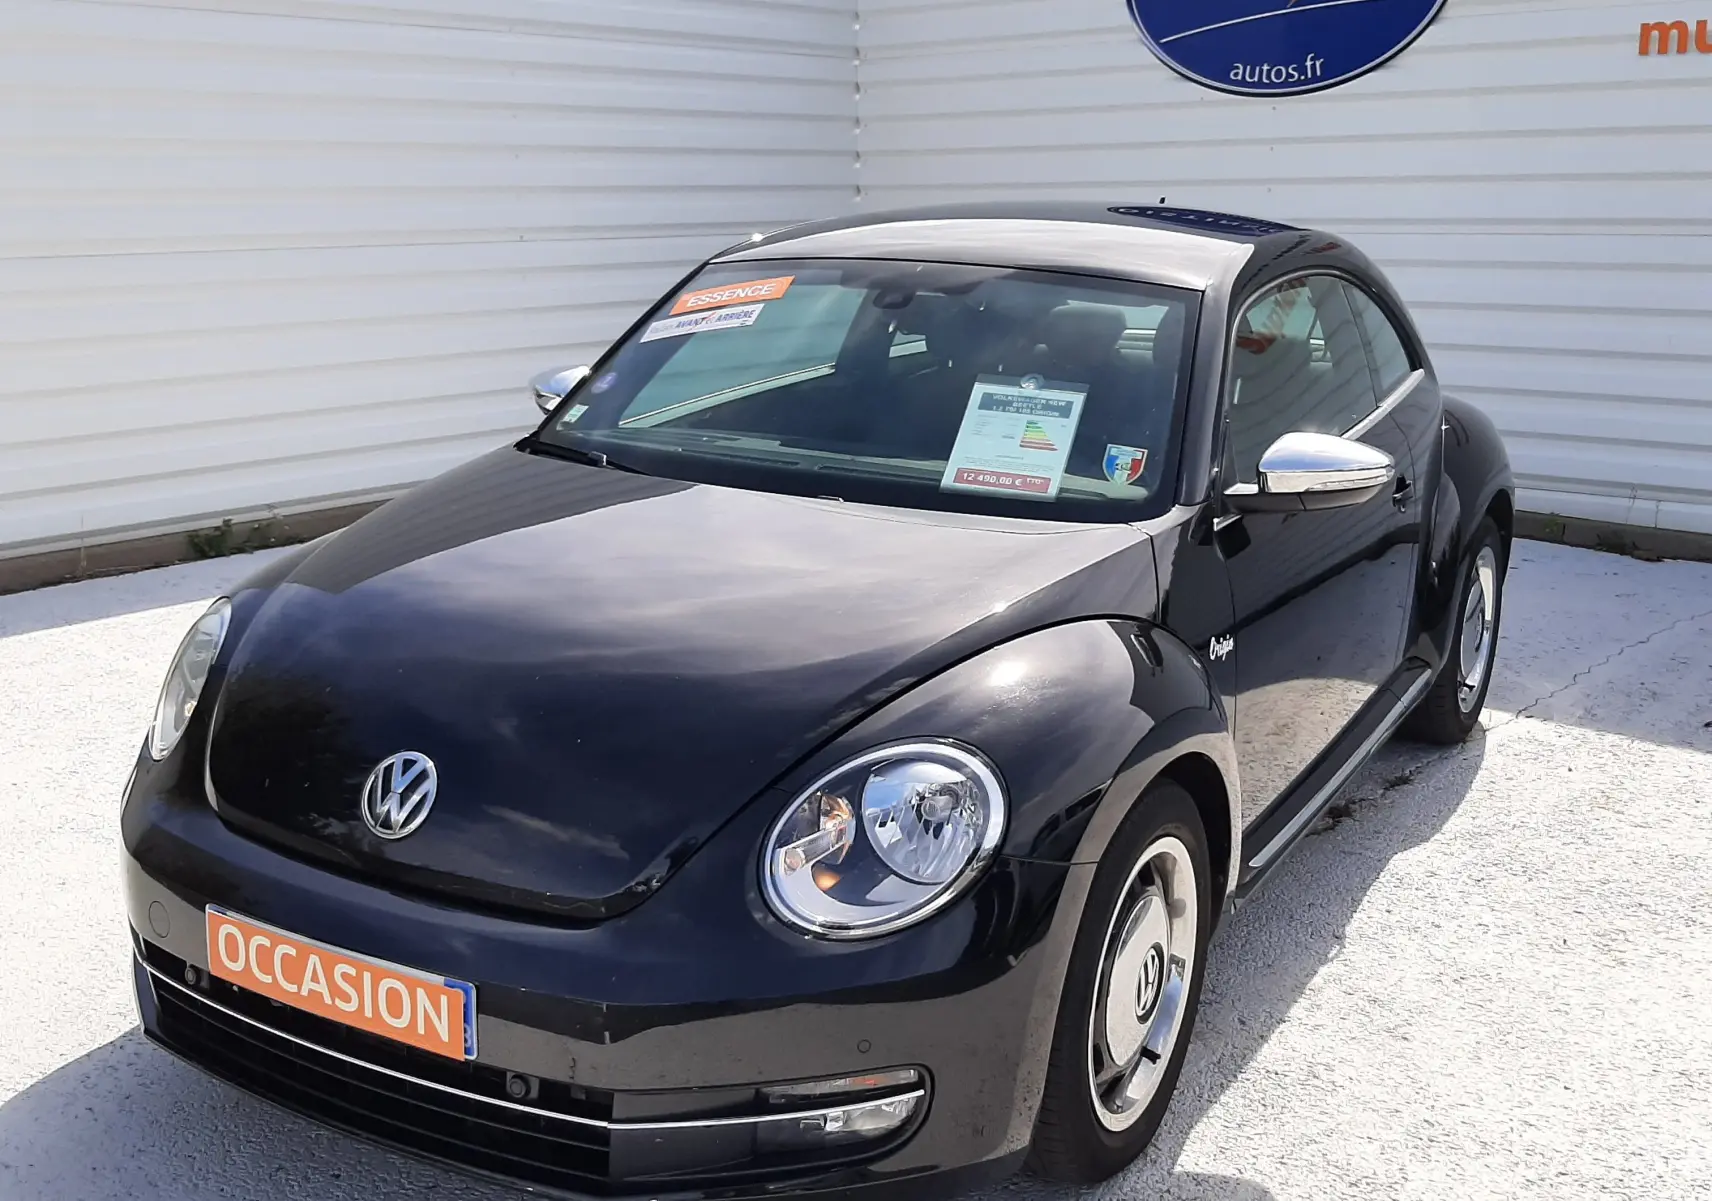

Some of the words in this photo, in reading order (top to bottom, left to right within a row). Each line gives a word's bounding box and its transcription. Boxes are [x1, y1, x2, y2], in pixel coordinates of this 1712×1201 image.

[1229, 53, 1324, 83] autos.fr
[687, 284, 776, 307] ESSENCE
[675, 317, 705, 330] AVANT
[714, 309, 756, 323] ARRIÈRE
[962, 472, 974, 481] 12
[1015, 478, 1023, 486] €
[217, 923, 449, 1042] OCCASION
